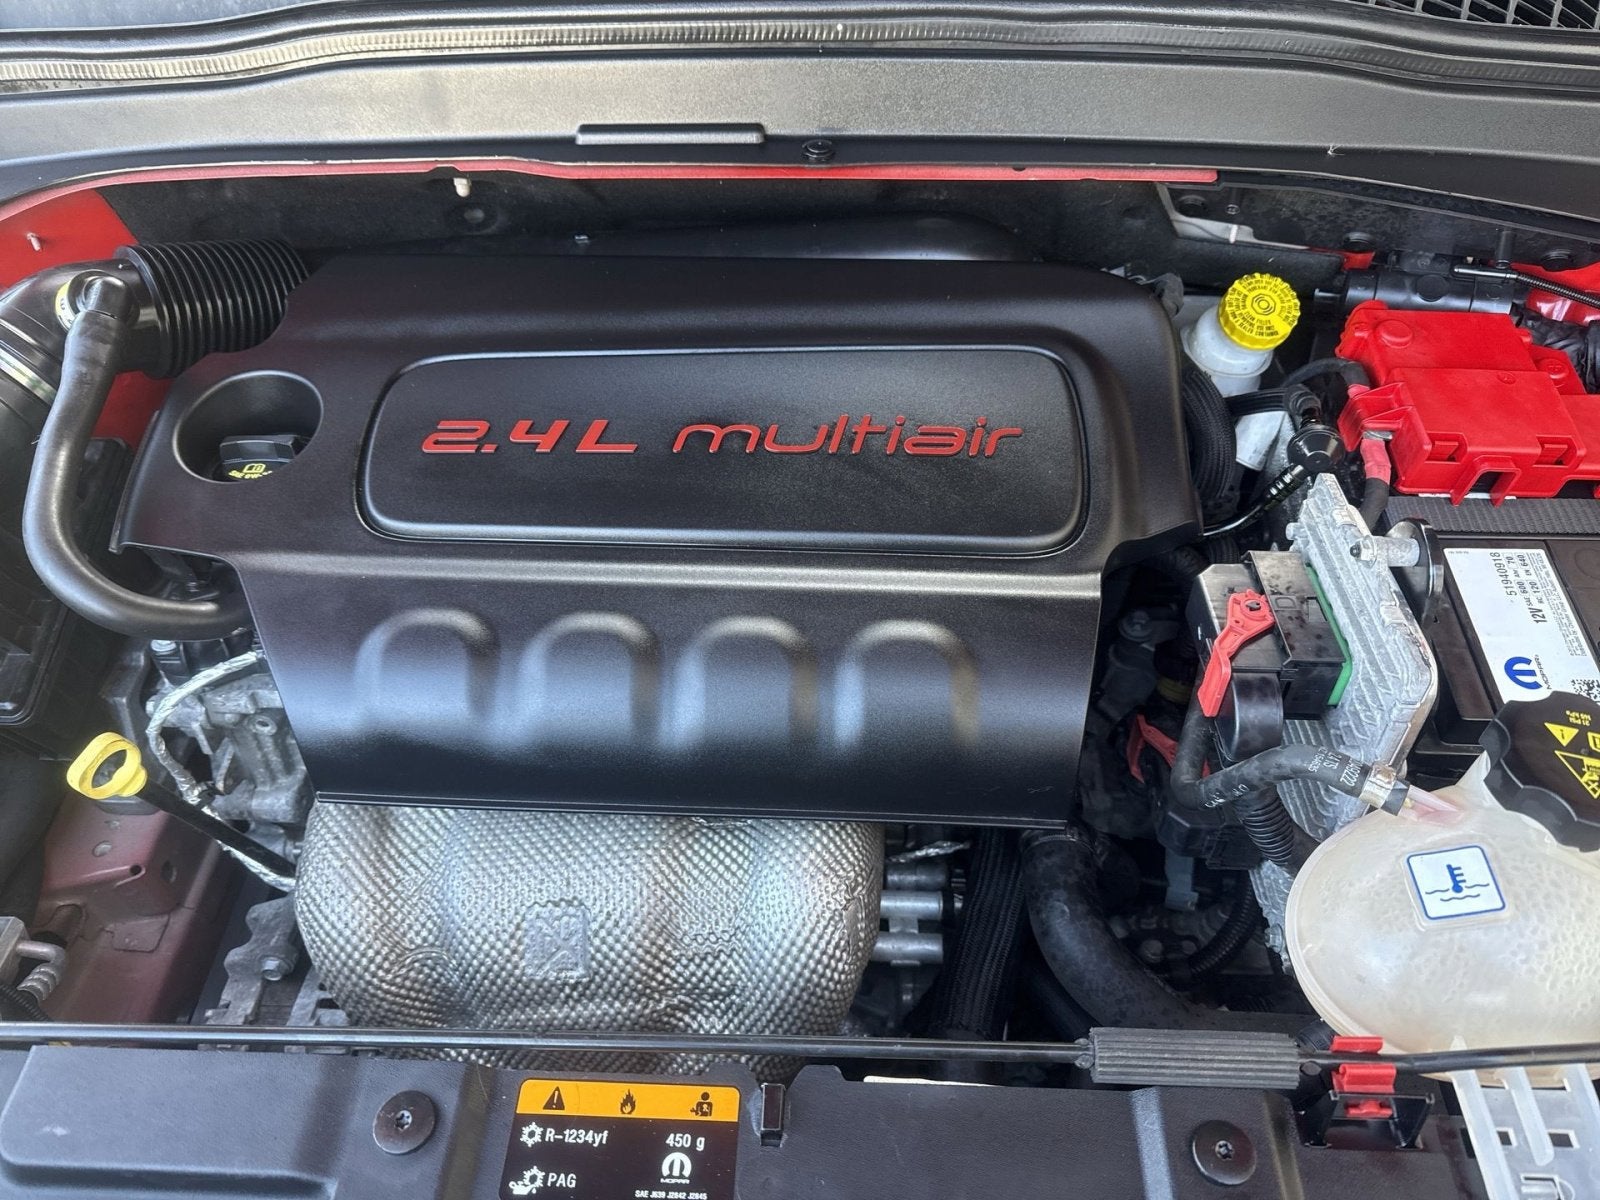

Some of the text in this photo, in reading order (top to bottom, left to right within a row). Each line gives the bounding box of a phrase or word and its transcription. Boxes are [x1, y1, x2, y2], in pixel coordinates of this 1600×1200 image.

[672, 414, 1023, 457] multiair
[1506, 556, 1515, 564] 70
[1517, 554, 1528, 567] 640
[1489, 552, 1518, 596] 51940918
[1516, 581, 1528, 594] 600
[1528, 581, 1540, 594] 120
[1528, 607, 1548, 624] 12V
[545, 1128, 706, 1151] R-1234yf 450 g
[546, 1174, 577, 1188] PAG
[634, 1190, 649, 1198] SAE
